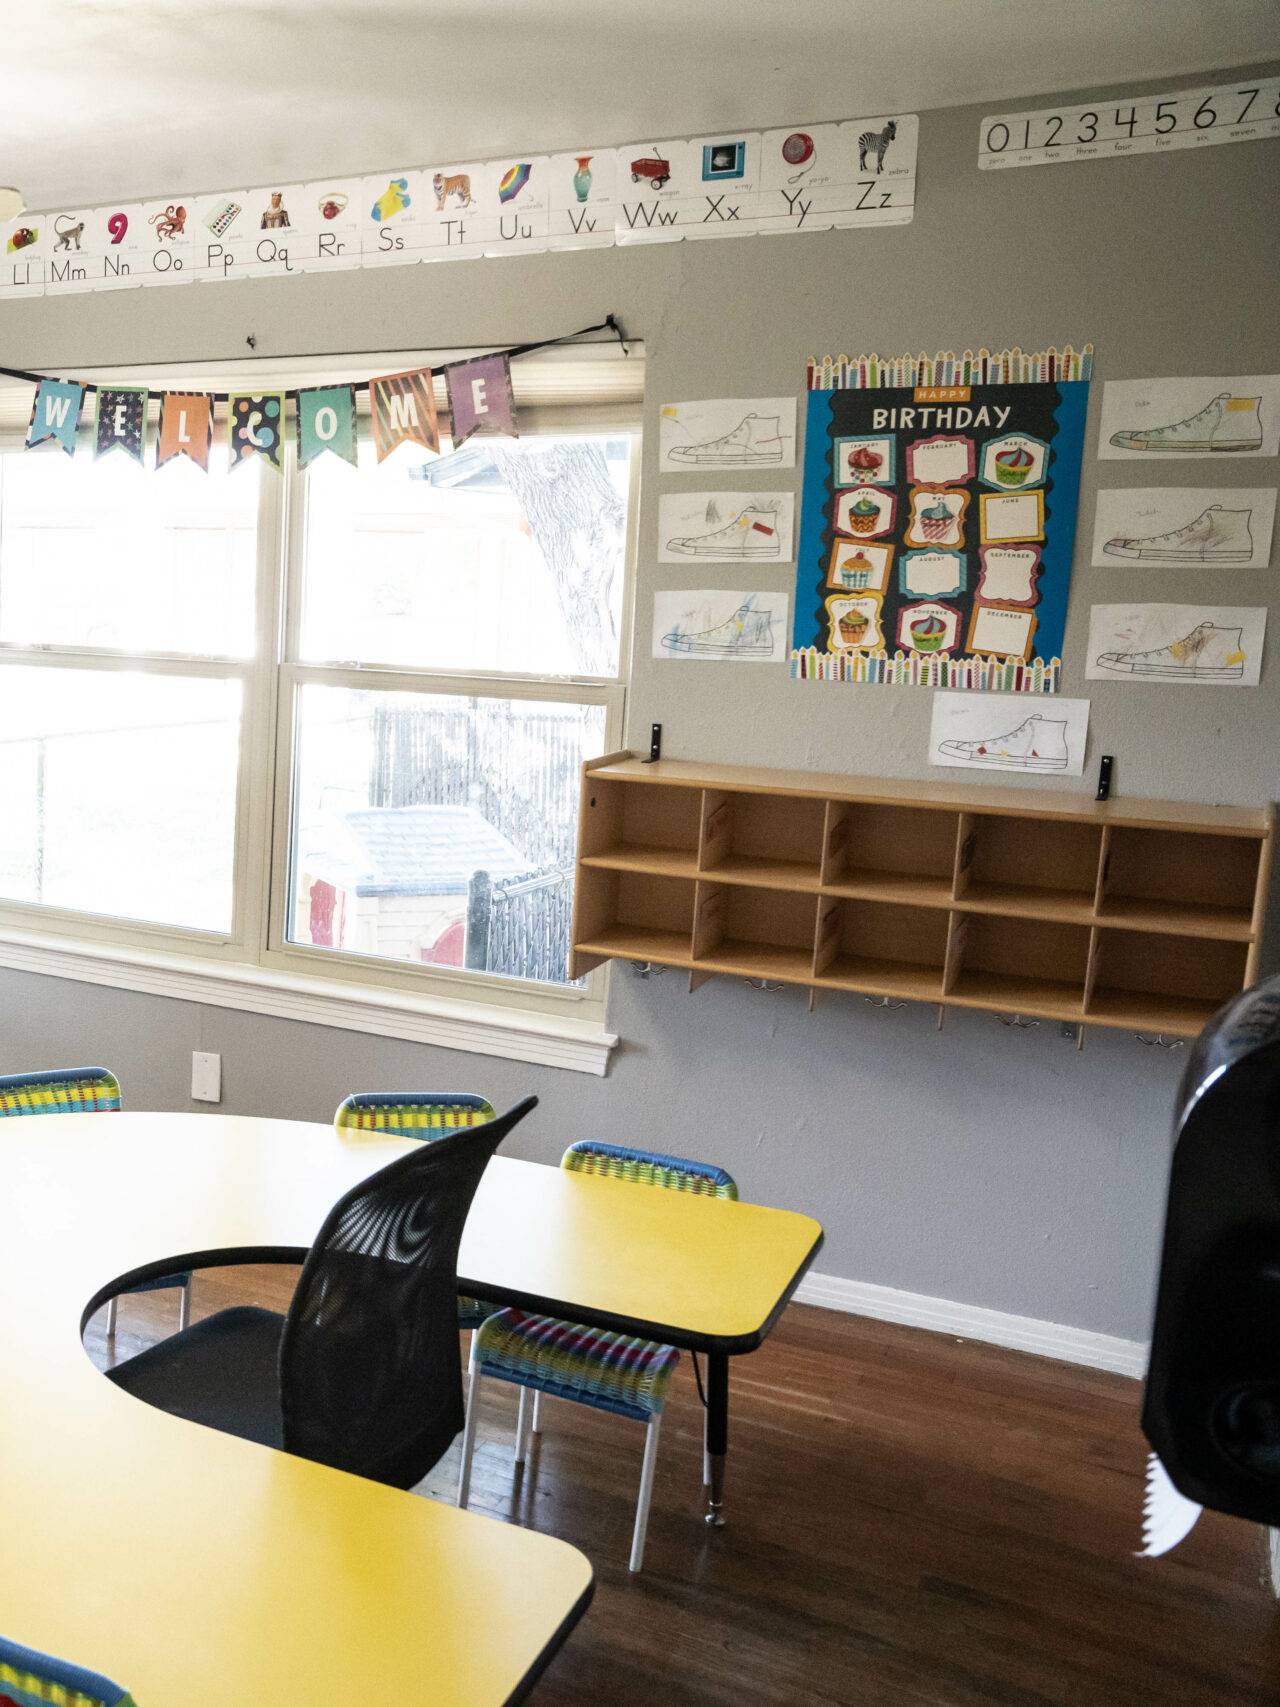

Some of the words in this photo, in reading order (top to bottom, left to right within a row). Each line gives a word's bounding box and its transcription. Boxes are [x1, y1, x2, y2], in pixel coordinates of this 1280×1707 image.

[986, 122, 1010, 153] 0
[1023, 119, 1030, 149] 1
[1044, 116, 1063, 147] 2
[1077, 112, 1099, 143] 3
[1114, 106, 1138, 138] 4
[1154, 101, 1178, 134] 5
[1193, 96, 1217, 129] 6
[1237, 88, 1260, 124] 7
[12, 263, 30, 285] Ll
[50, 259, 86, 282] Mm
[104, 253, 130, 276] Nn
[153, 249, 183, 272] Oo
[207, 243, 234, 276] Pp
[256, 239, 293, 271] Qq
[318, 232, 346, 257] Rr
[378, 227, 404, 252] Ss
[440, 220, 466, 245] Tt
[499, 215, 532, 240] Uu
[567, 208, 597, 234] Vv
[622, 200, 678, 229] Ww
[702, 194, 740, 224] Xx
[780, 187, 812, 228] Yy
[855, 181, 893, 210] Zz
[45, 378, 487, 447] WELCOME
[918, 389, 967, 400] HAPPY
[872, 405, 1011, 430] BIRTHDAY
[989, 552, 1030, 560] SEPTEMBER
